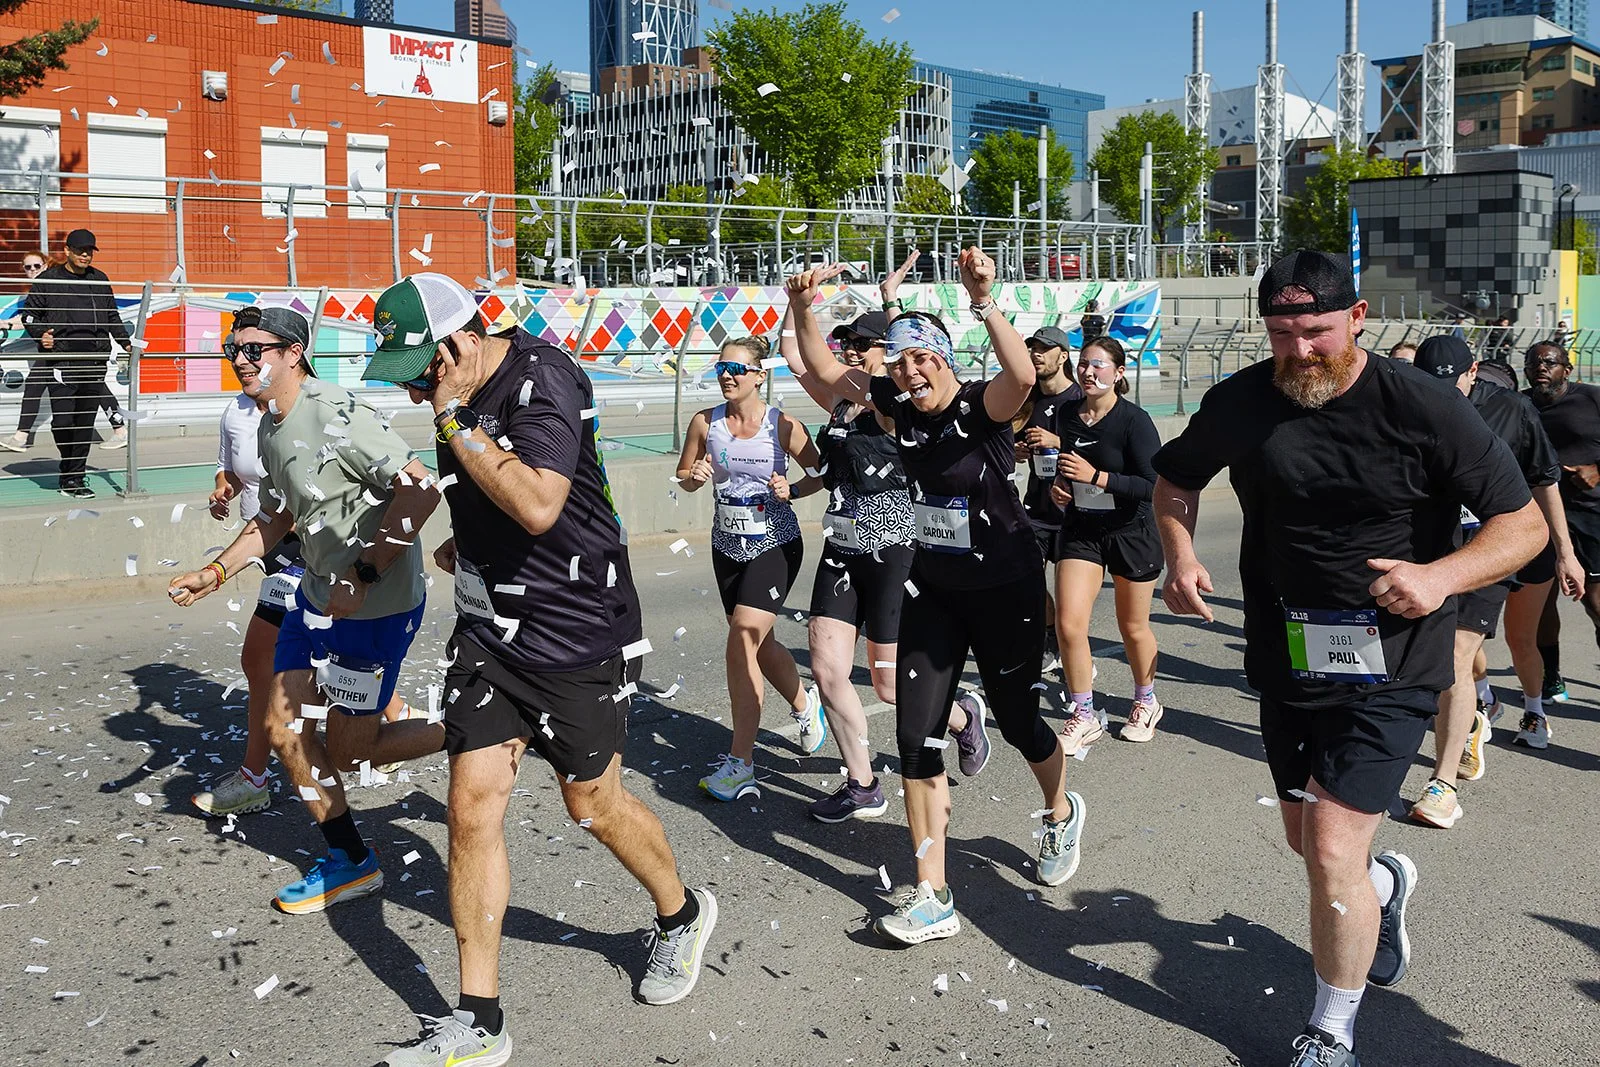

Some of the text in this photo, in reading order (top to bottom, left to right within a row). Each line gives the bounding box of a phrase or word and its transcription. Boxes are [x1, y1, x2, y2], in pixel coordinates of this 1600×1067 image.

[389, 33, 454, 61] IMPACT
[393, 55, 418, 63] BOXING
[723, 517, 749, 531] CAT
[922, 526, 956, 540] CAROLYN
[269, 588, 287, 601] EMIL
[1329, 634, 1353, 646] 3161
[1328, 651, 1361, 665] PAUL
[338, 675, 357, 687] 6557
